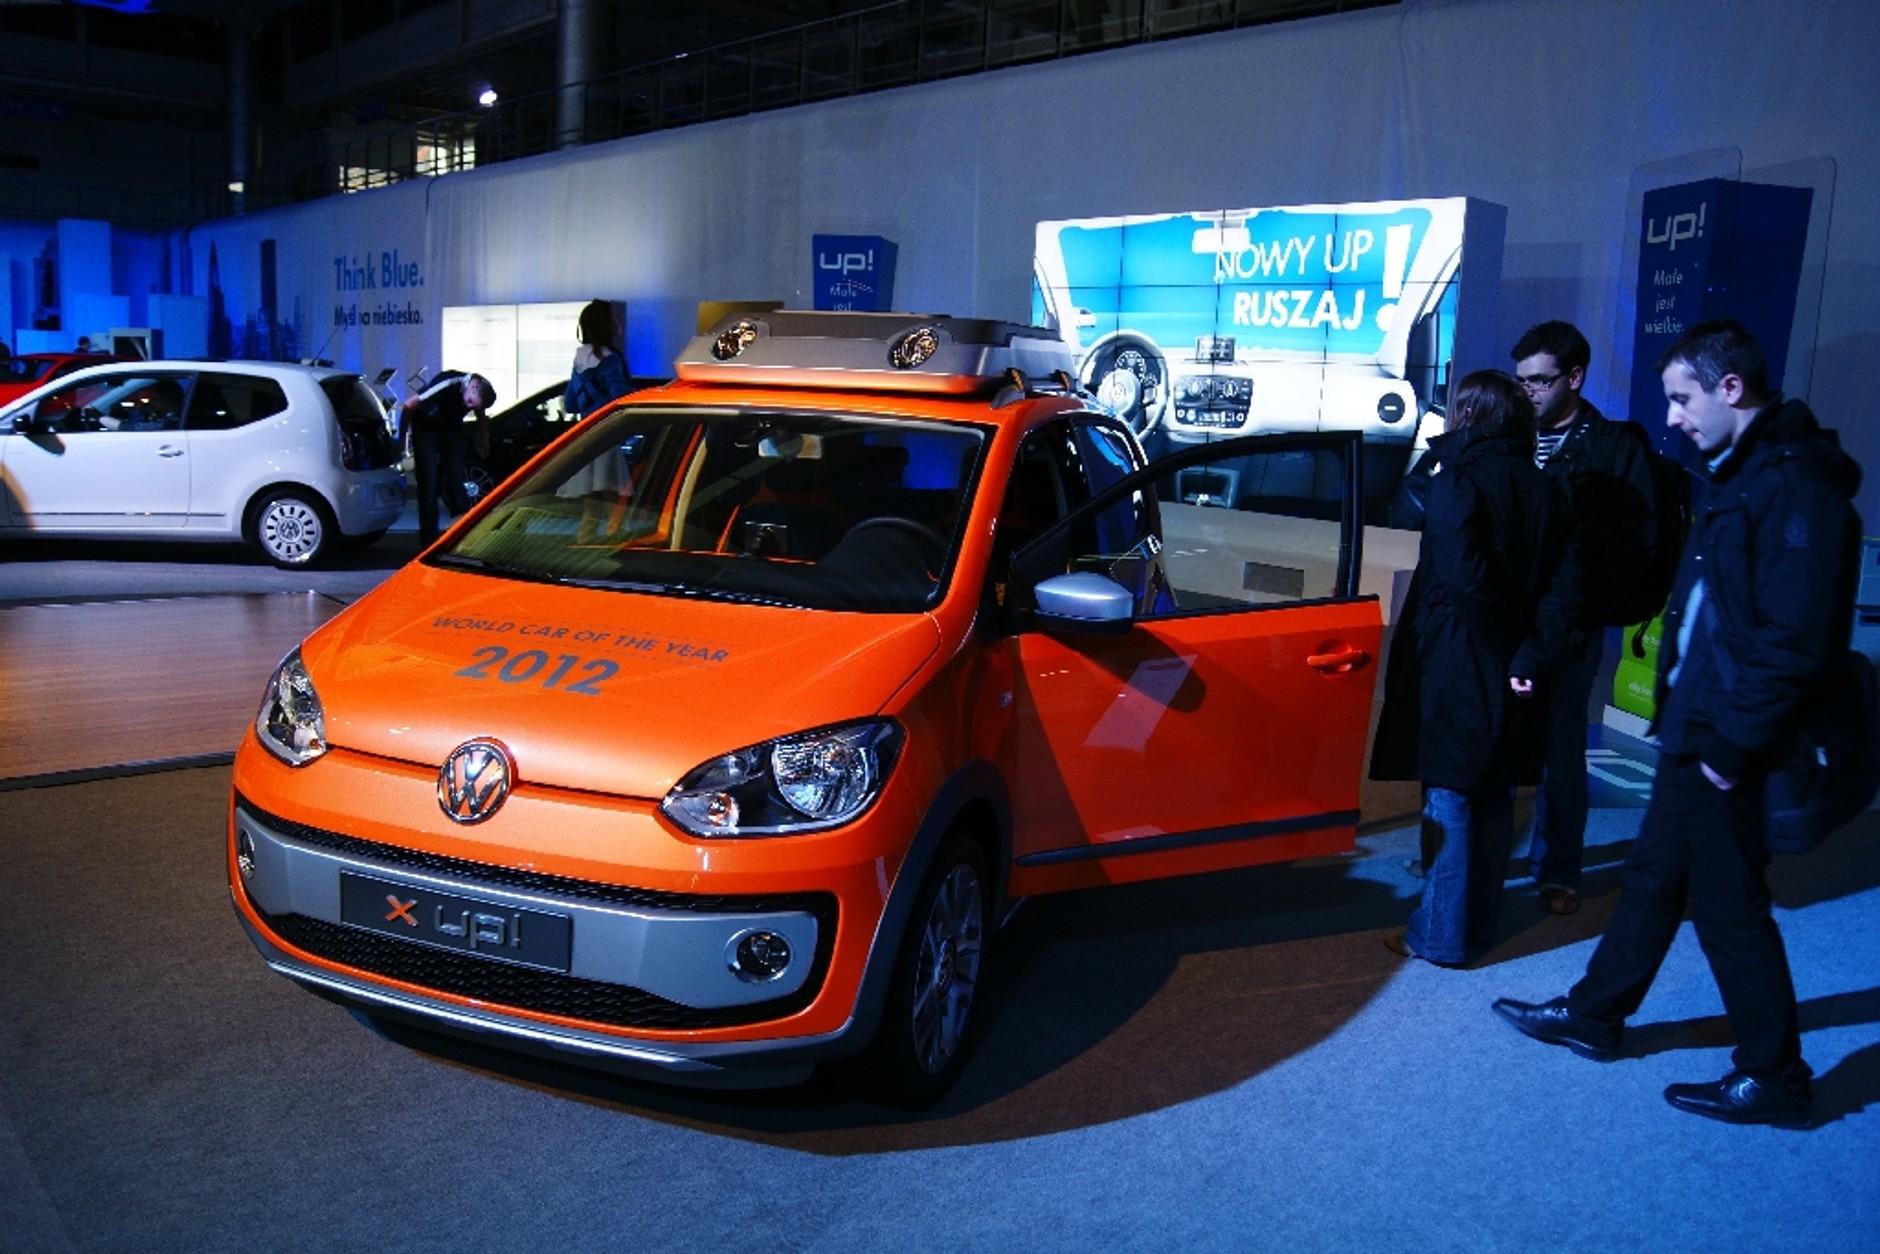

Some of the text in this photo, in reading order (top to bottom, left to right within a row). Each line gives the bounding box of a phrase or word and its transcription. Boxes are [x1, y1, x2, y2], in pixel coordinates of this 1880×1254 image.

[1647, 202, 1707, 250] up!
[334, 249, 424, 291] Think Blue.
[820, 249, 874, 276] up!
[1216, 235, 1316, 278] NOWY
[1324, 229, 1374, 272] UP
[373, 301, 424, 325] niebiesko.
[1233, 289, 1366, 330] RUSZAJ
[432, 616, 730, 662] WORLD CAR OF THE YEAR
[454, 646, 621, 695] 2012
[385, 895, 521, 949] X up!
